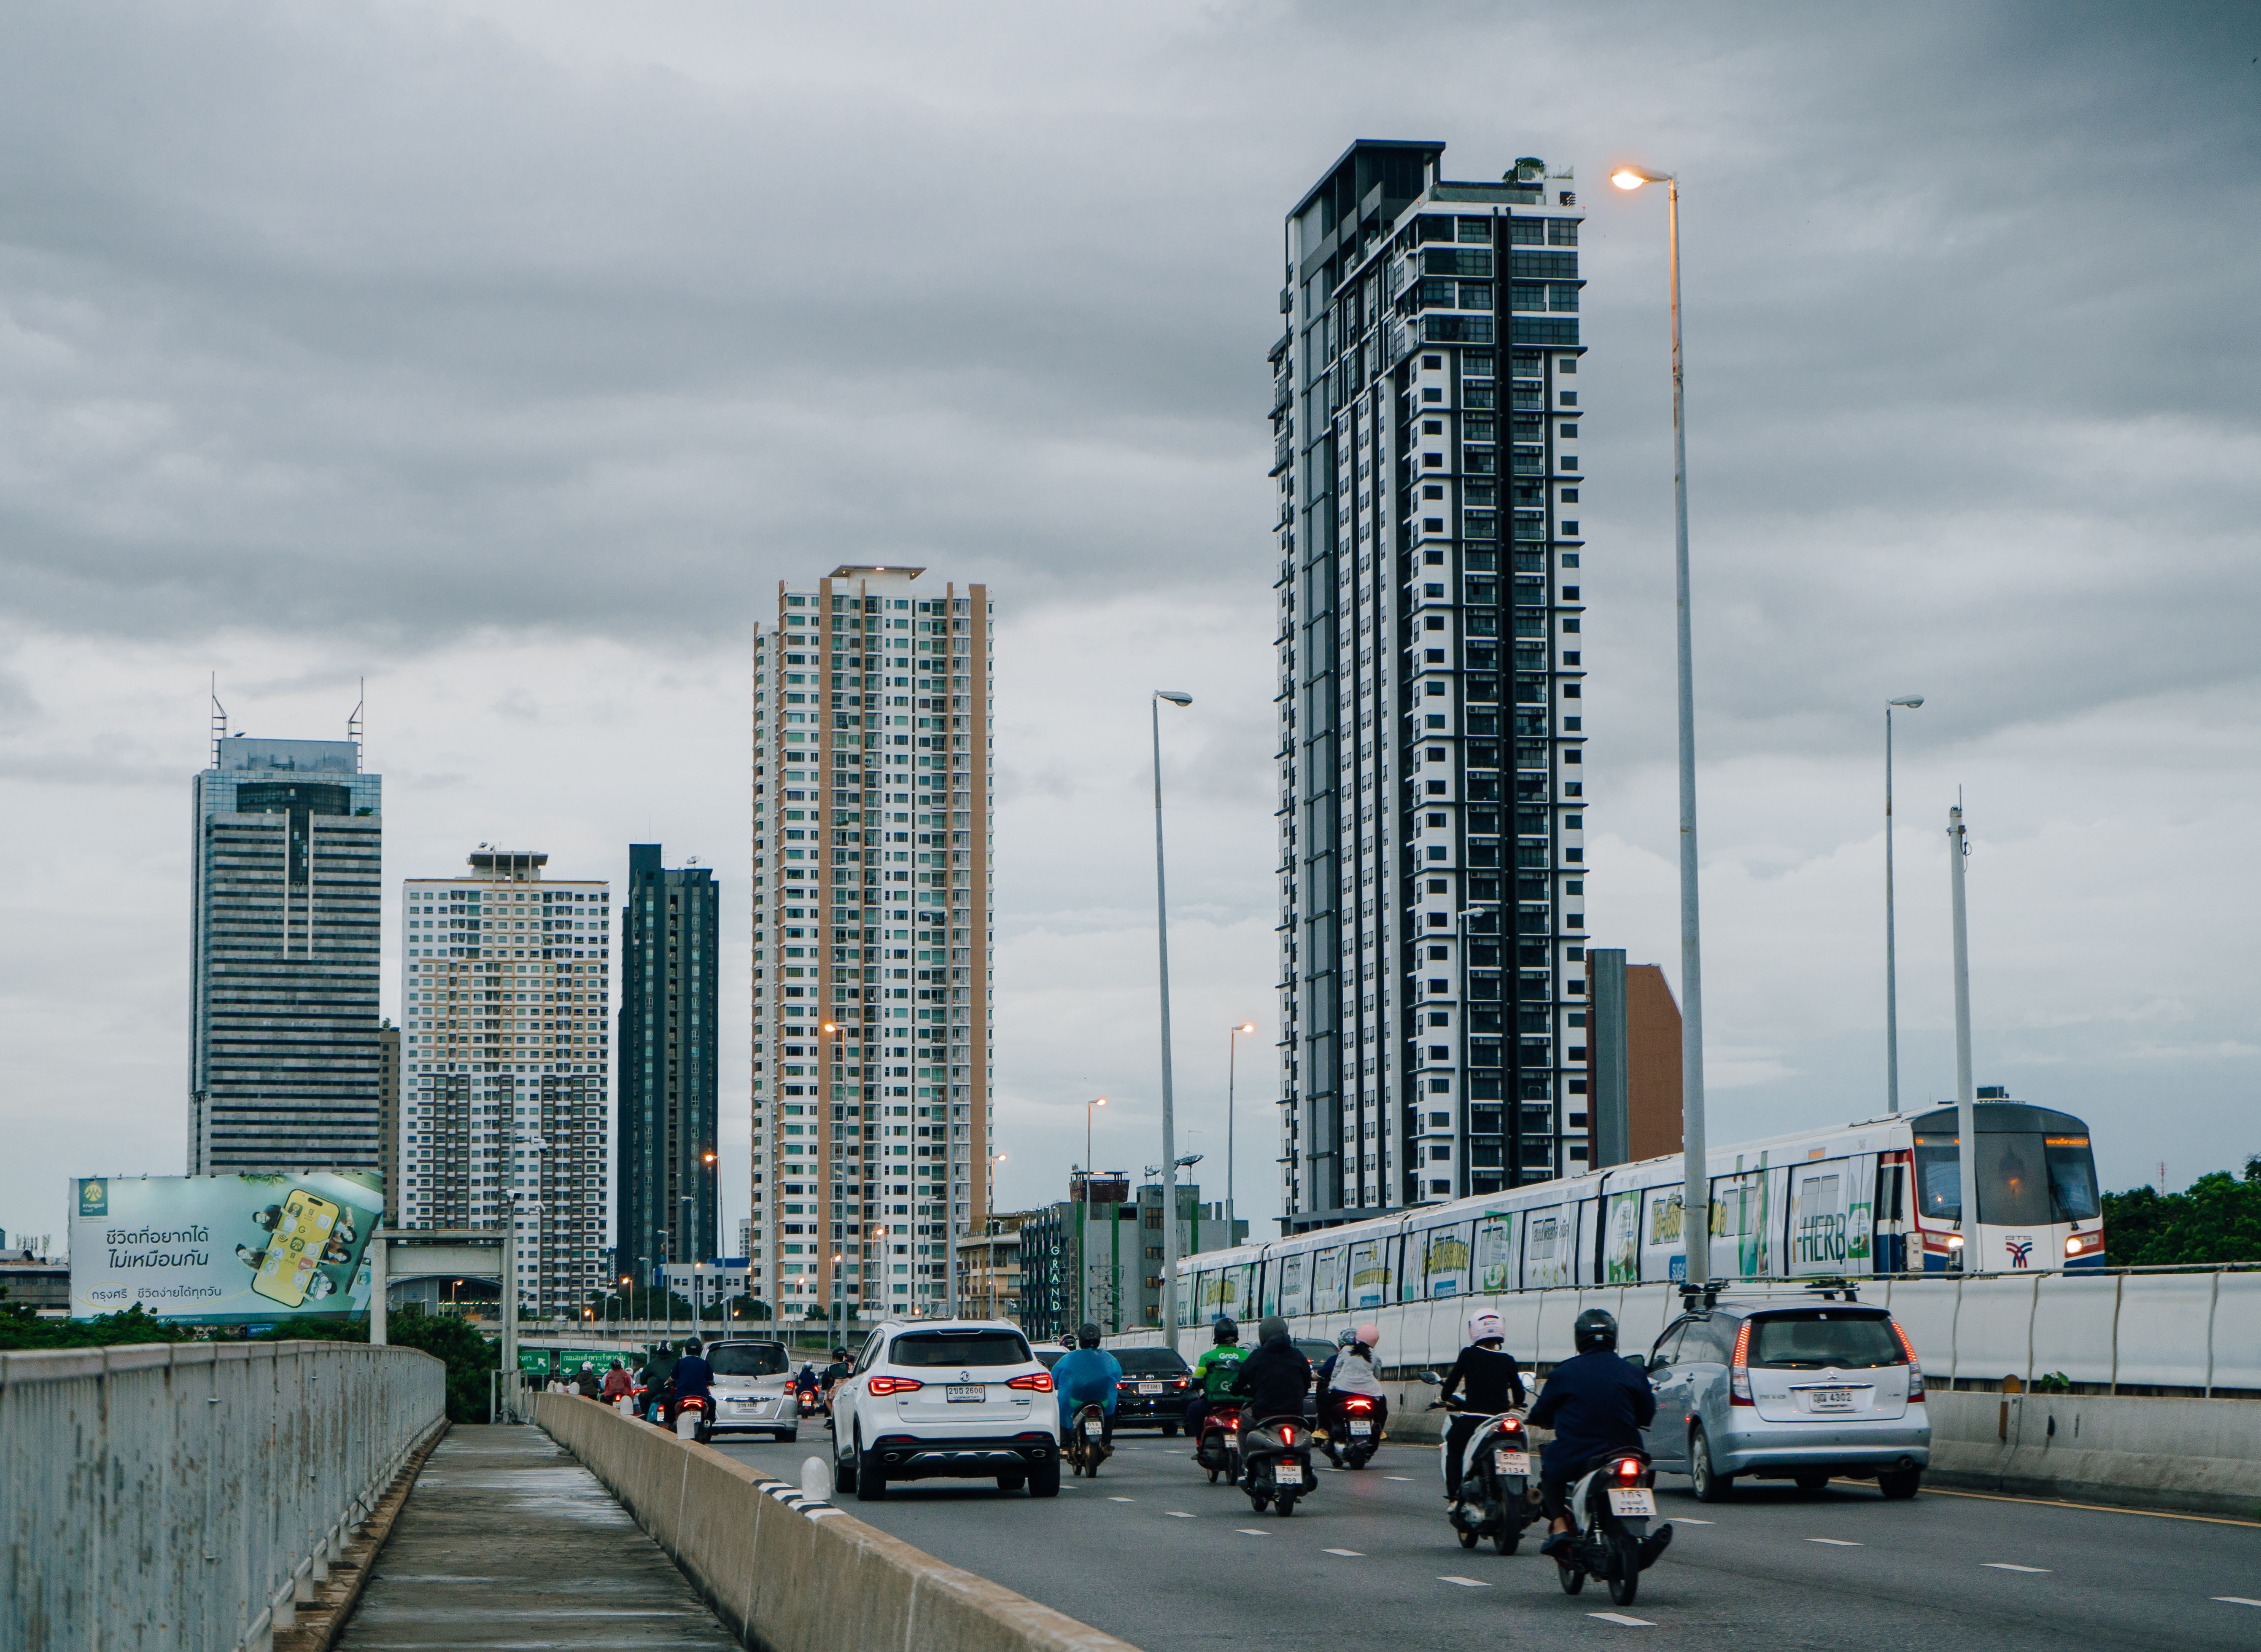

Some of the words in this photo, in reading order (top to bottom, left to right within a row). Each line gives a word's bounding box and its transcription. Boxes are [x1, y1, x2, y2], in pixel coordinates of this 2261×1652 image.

[106, 1225, 209, 1244] ชีวิตที่อยากได้
[108, 1249, 209, 1268] ไม่เหมือนกัน
[92, 1288, 127, 1302] กรุงศรี
[138, 1285, 221, 1299] ชีวิตง่ายได้ทุกวัน
[959, 1371, 970, 1382] MG
